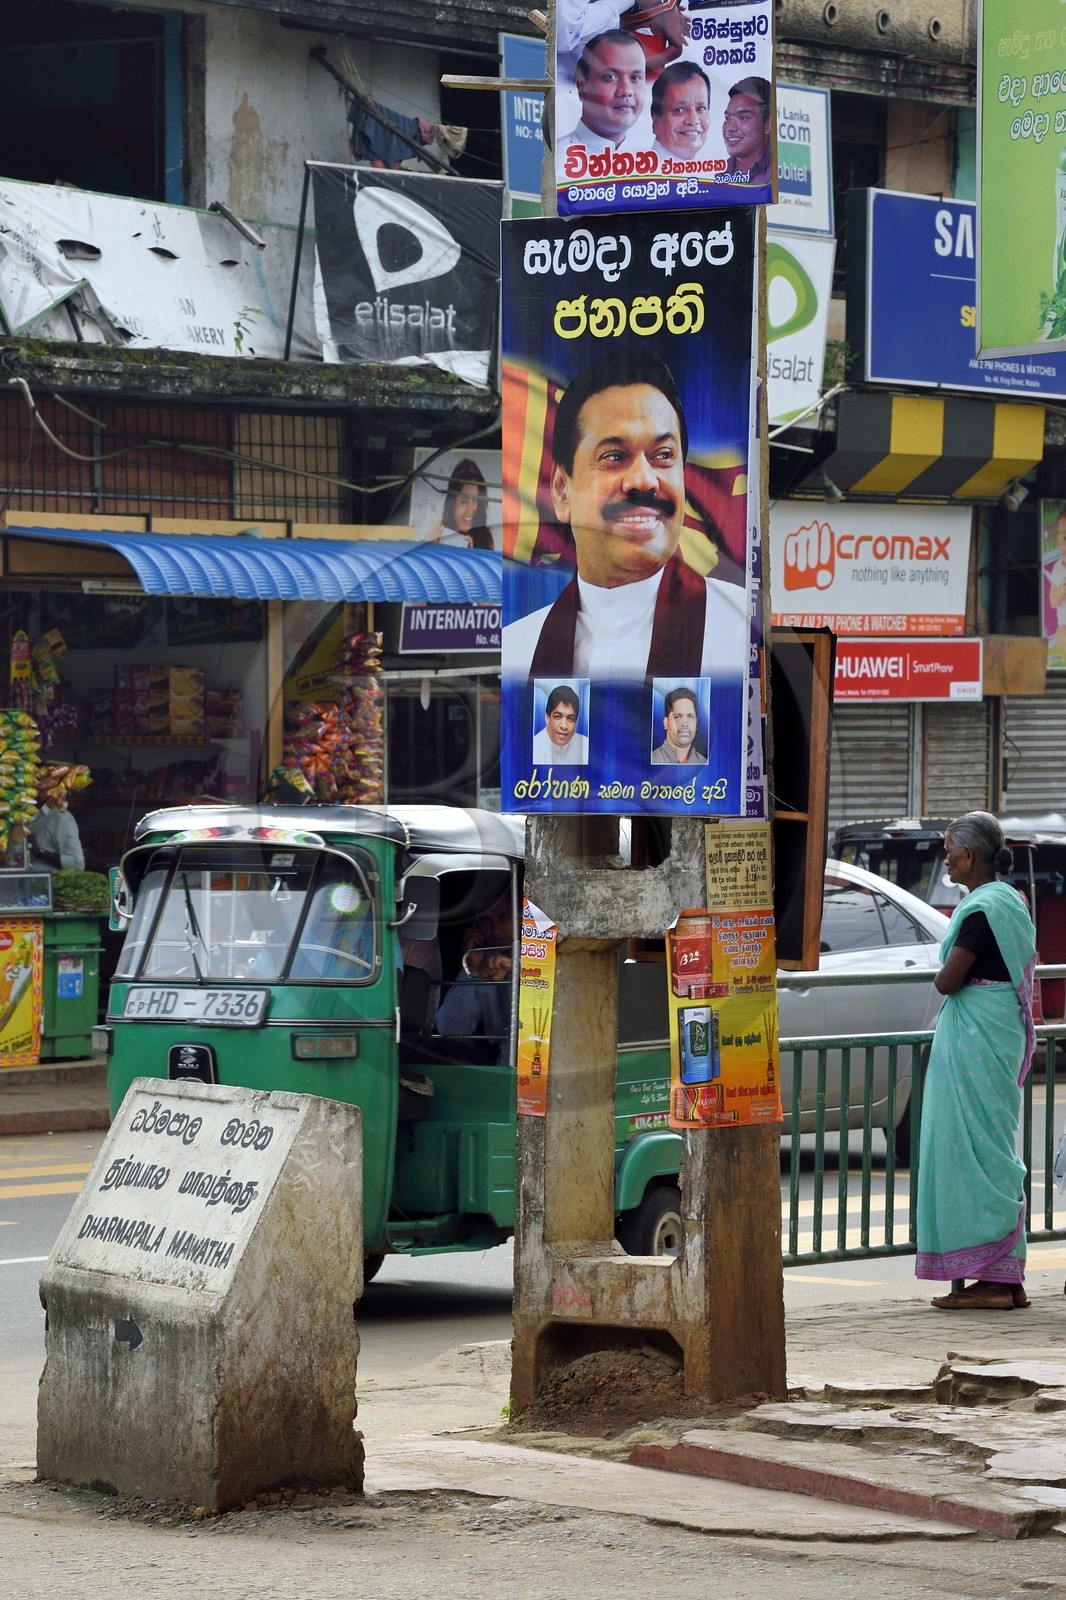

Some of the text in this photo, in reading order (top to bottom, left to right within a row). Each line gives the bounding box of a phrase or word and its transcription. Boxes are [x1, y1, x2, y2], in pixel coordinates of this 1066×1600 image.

[691, 14, 768, 43] මිනිස්සුන්ට
[703, 41, 756, 66] මතකයි
[783, 107, 810, 123] Lanka
[564, 145, 727, 178] චින්තන ඒකනායක
[568, 184, 617, 202] මාතලේ
[622, 179, 670, 197] යොවුන්
[523, 221, 734, 283] සැමදා අපේ
[354, 296, 457, 333] etisalat
[553, 282, 705, 339] ජනපති
[994, 361, 1020, 373] PHONES
[1026, 365, 1056, 377] WATCHES
[852, 566, 949, 585] nothing like anything
[410, 608, 502, 630] INTERNATIO
[836, 615, 863, 631] PHONE
[863, 616, 870, 631] &
[871, 615, 907, 631] WATCHES
[475, 634, 500, 646] No. 48,
[834, 656, 953, 679] HUAWEI SmartPhone
[513, 768, 590, 800] රෝහණ
[640, 776, 696, 805] මාතලේ
[701, 778, 728, 804] අපි
[203, 992, 259, 1017] 7336
[652, 1082, 665, 1091] Friend
[635, 1116, 652, 1130] KING
[653, 1115, 662, 1127] OF
[77, 1214, 236, 1269] DHARMAPALA MAWATHA
